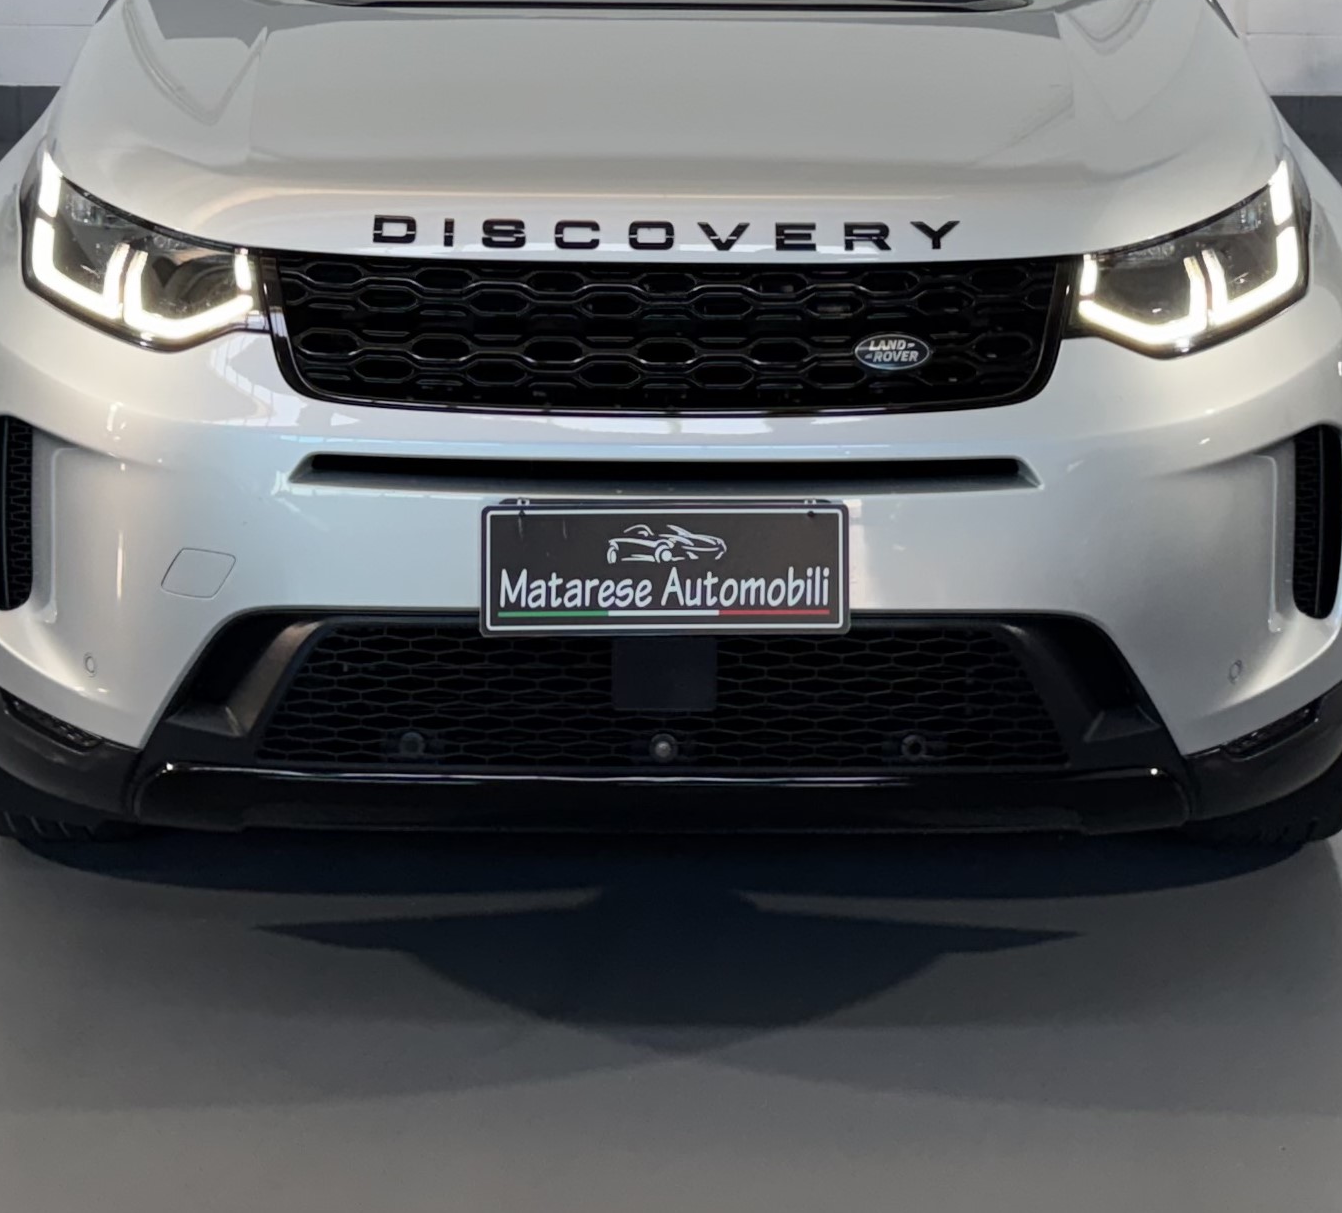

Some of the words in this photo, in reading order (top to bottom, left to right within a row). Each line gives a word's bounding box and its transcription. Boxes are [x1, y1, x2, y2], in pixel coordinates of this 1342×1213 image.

[372, 214, 960, 252] DISCOVERY
[869, 339, 907, 351] LAND
[872, 350, 919, 363] ROVER
[499, 568, 653, 609] Matarese
[660, 566, 830, 607] Automobili
